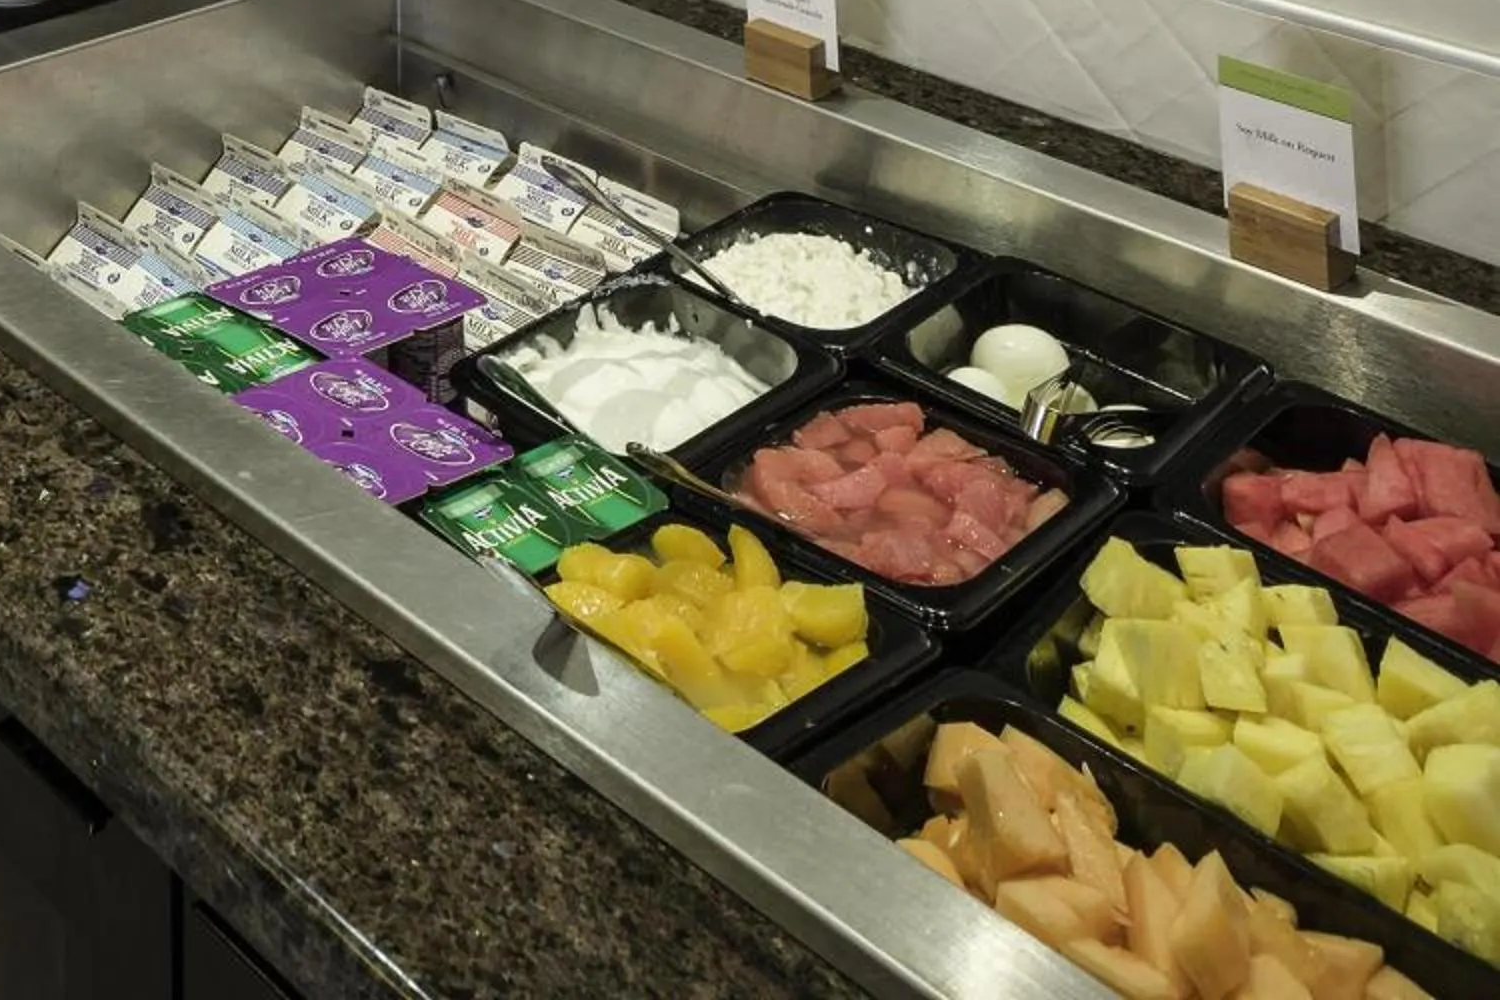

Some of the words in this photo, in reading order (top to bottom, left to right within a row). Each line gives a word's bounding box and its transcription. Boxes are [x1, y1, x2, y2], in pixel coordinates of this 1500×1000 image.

[1296, 141, 1336, 163] Request
[307, 204, 328, 222] MILK
[231, 245, 252, 265] MILK
[161, 306, 236, 338] ACTIVIA
[468, 317, 494, 341] MILK
[224, 337, 302, 376] ACTIVIA
[547, 465, 629, 511] ACTIVIA
[460, 502, 548, 552] ACTIVIA
